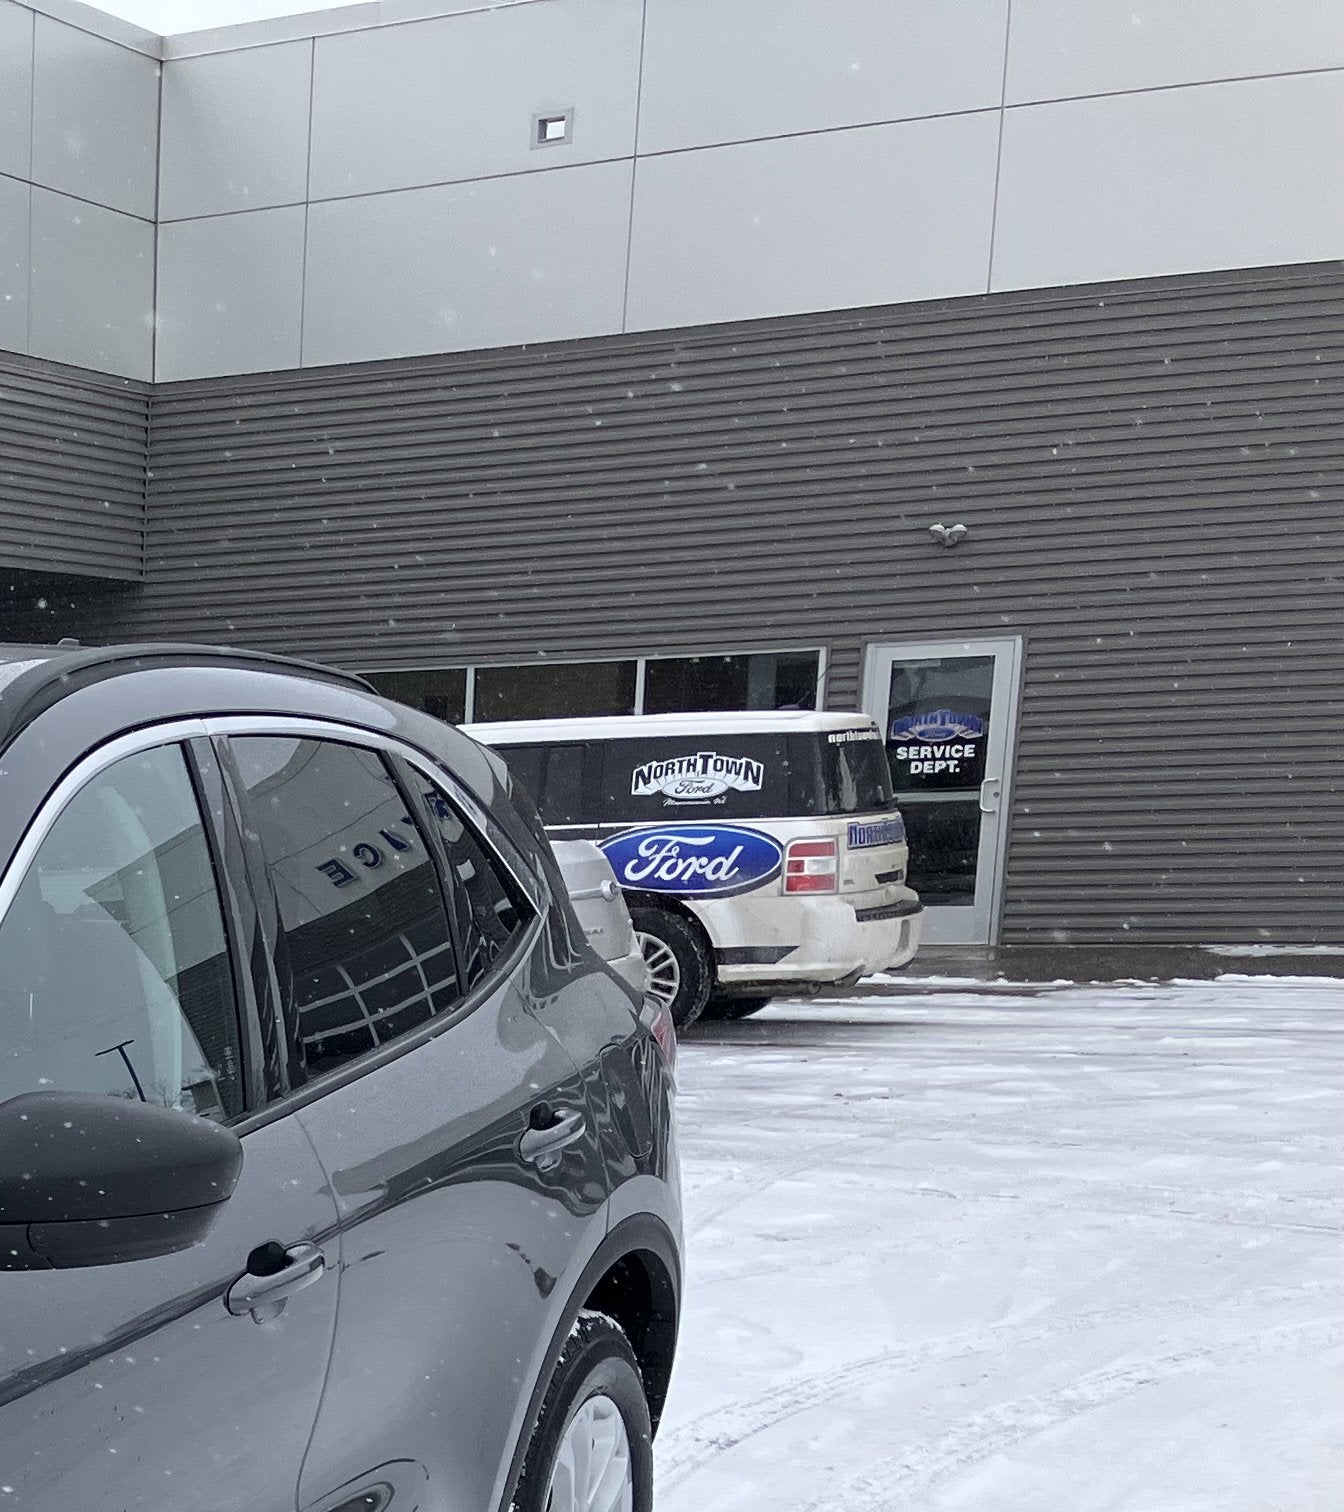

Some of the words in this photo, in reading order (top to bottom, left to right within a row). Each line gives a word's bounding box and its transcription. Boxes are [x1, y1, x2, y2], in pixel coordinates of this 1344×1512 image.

[896, 744, 975, 760] SERVICE
[910, 760, 961, 774] DEPT.
[674, 780, 715, 795] Ford
[624, 835, 744, 881] Ford
